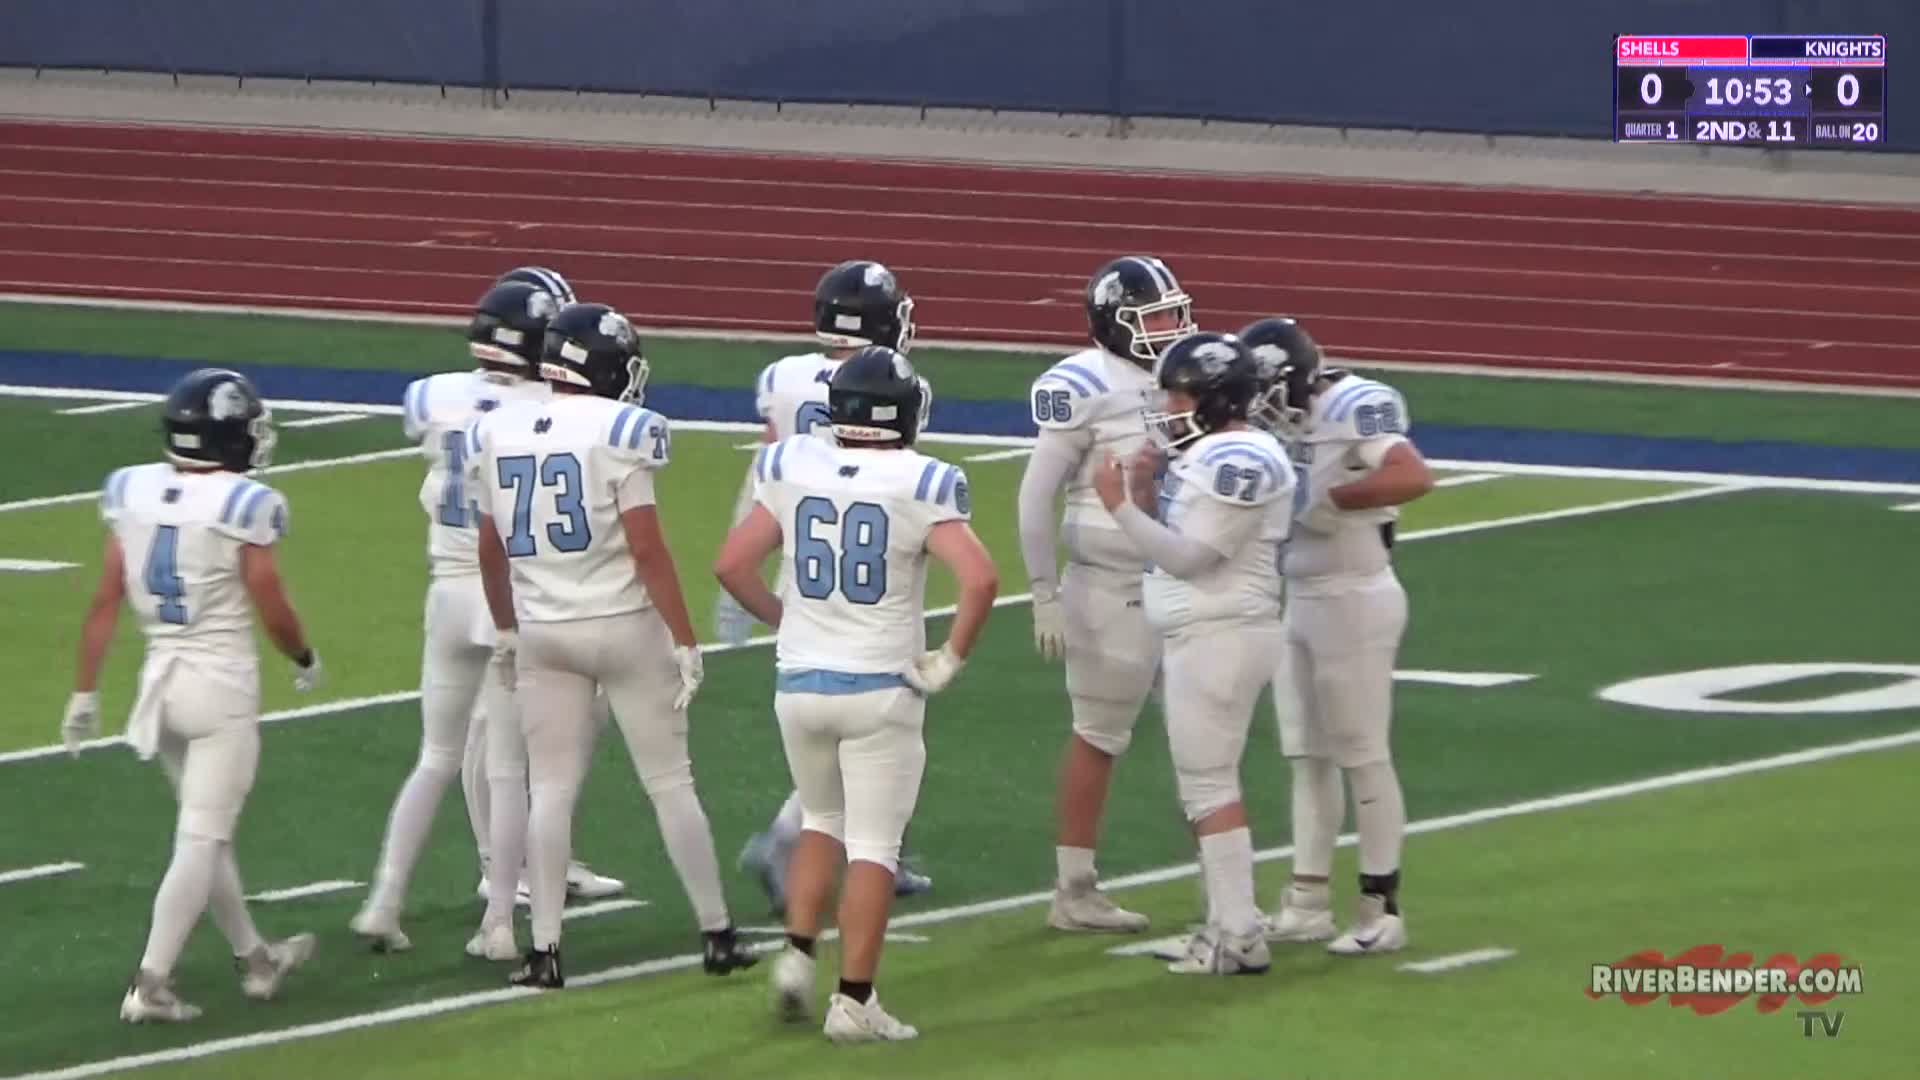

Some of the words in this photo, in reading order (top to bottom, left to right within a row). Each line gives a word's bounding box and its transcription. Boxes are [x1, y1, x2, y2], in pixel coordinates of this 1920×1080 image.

[1035, 390, 1072, 422] 65
[437, 430, 481, 528] 1
[497, 452, 592, 557] 73
[1214, 463, 1260, 501] 67
[145, 525, 188, 624] 4
[795, 495, 889, 605] 68
